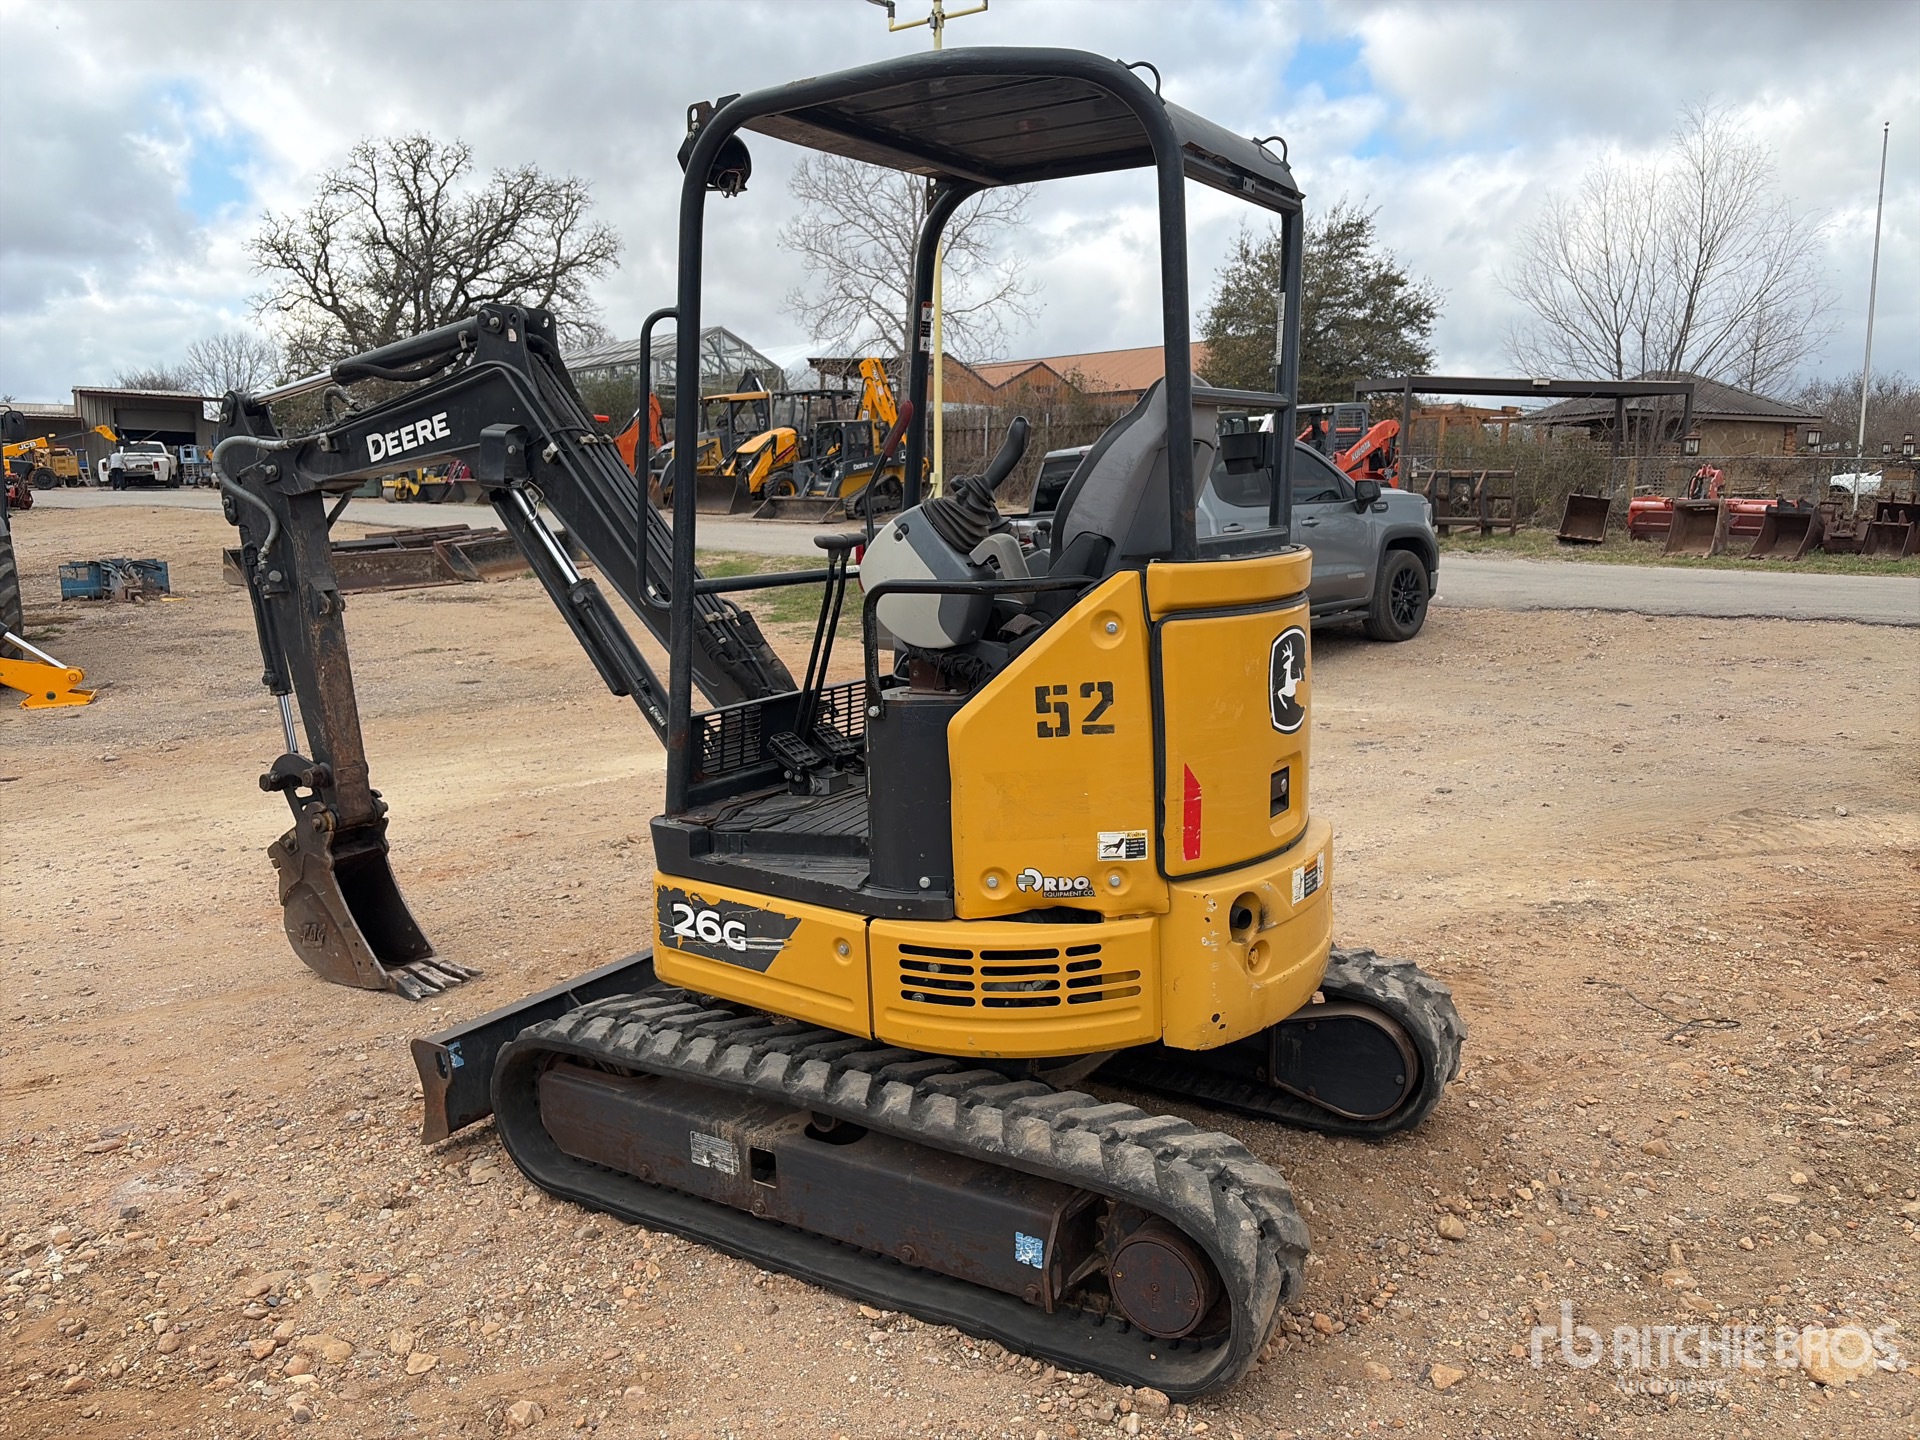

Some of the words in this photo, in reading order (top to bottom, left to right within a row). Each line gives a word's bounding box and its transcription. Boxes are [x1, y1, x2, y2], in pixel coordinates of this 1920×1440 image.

[18, 441, 37, 450] JCB
[366, 411, 451, 463] DEERE
[1035, 681, 1115, 738] 52
[1043, 890, 1082, 898] EQUIPMENT
[673, 903, 747, 951] 26G
